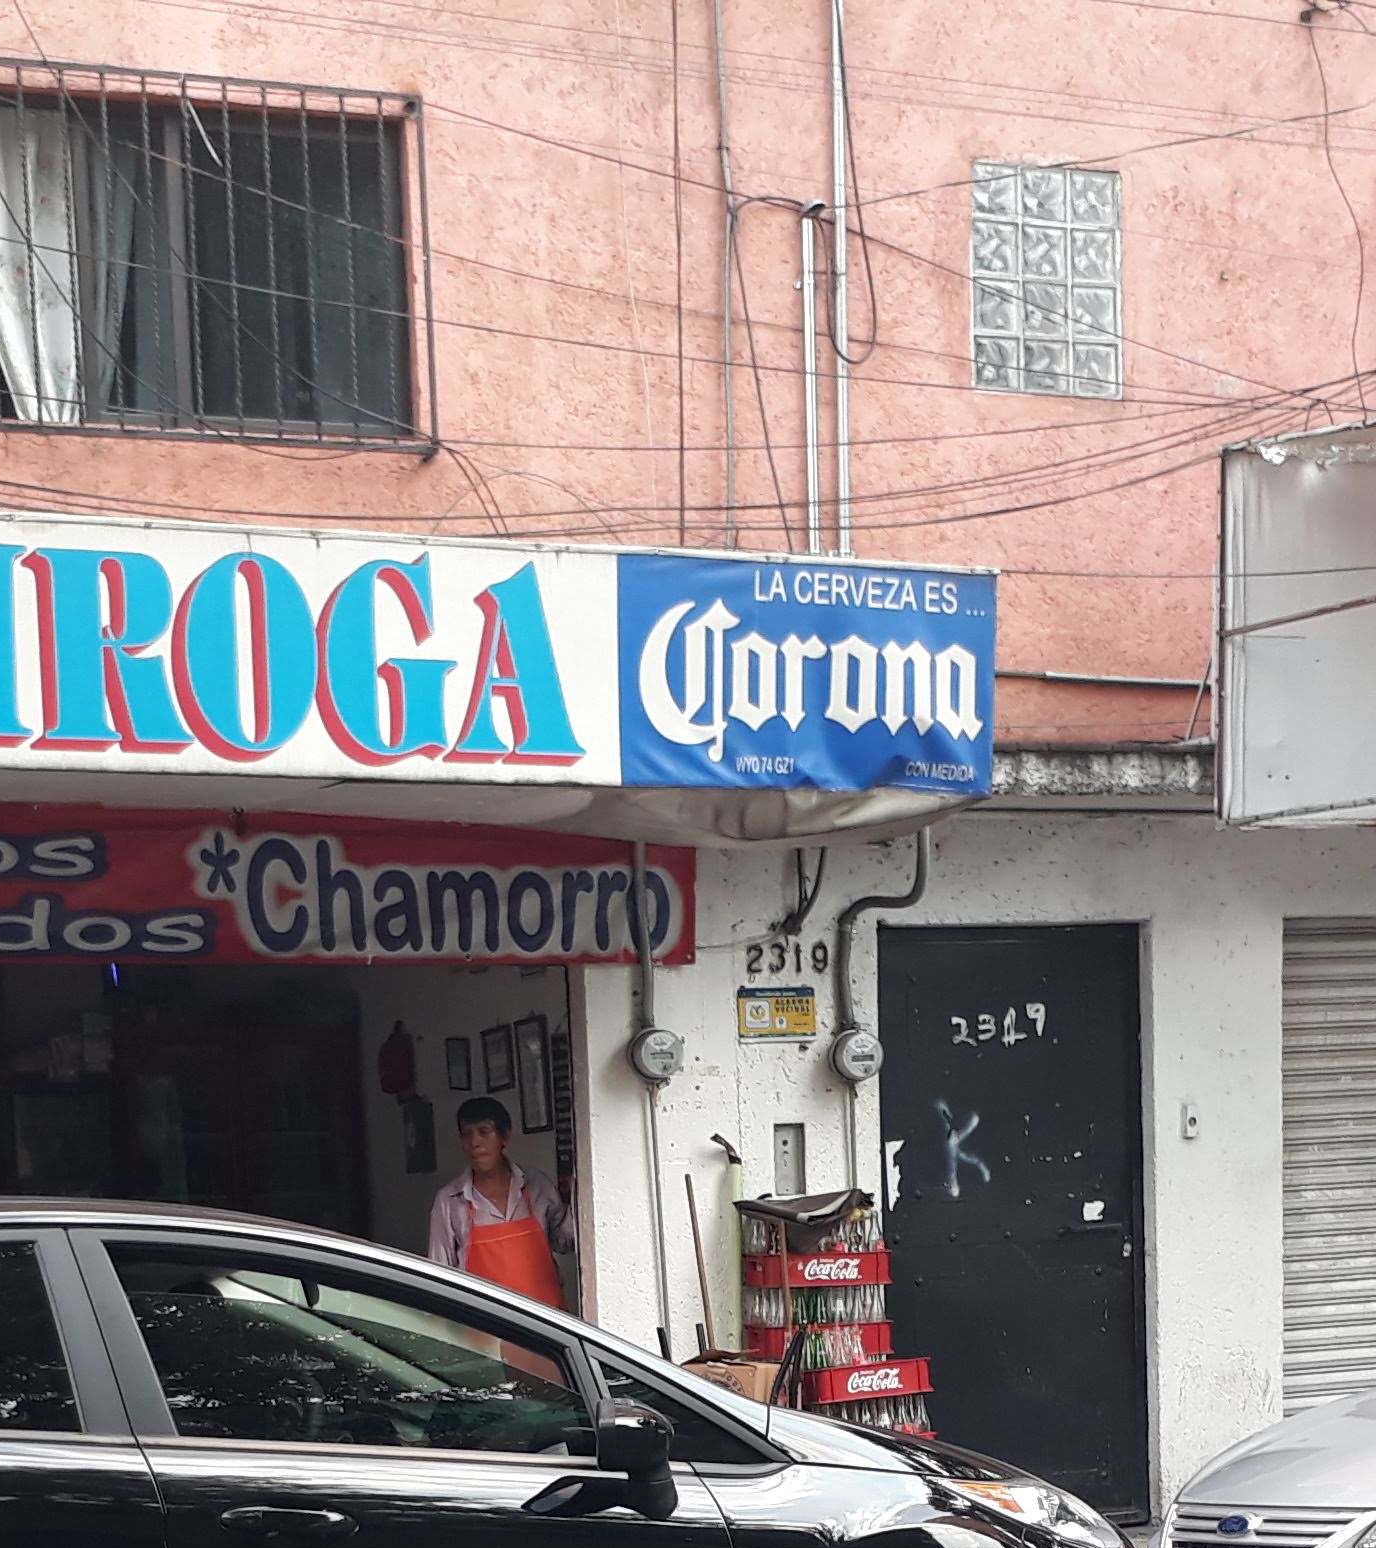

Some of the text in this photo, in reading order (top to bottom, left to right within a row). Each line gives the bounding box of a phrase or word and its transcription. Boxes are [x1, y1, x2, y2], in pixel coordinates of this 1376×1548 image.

[754, 569, 787, 602] LA
[794, 570, 917, 612] CERVEZA
[924, 581, 958, 615] ES
[638, 597, 984, 763] Corona
[905, 760, 974, 783] CON MEDIDA
[745, 941, 829, 974] 2319
[935, 1098, 991, 1197] K
